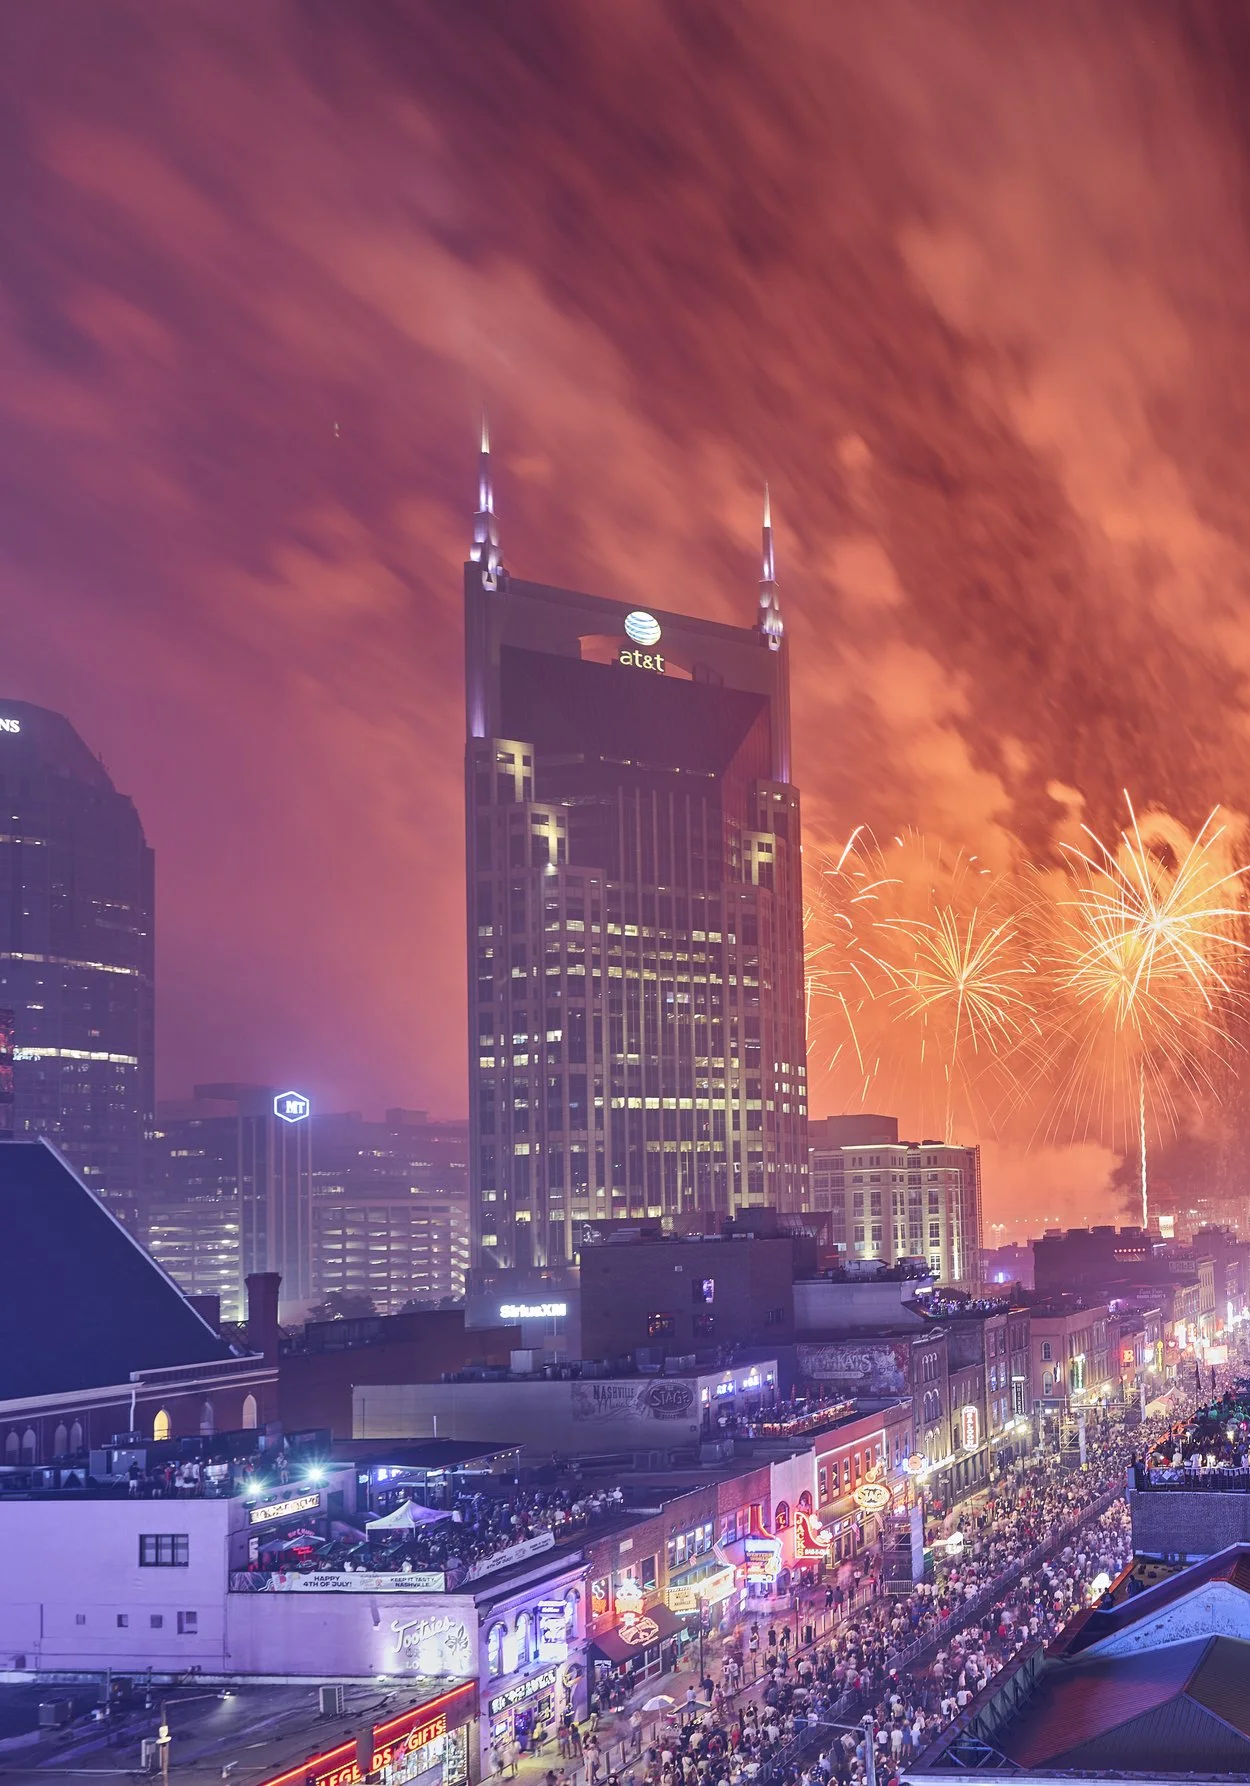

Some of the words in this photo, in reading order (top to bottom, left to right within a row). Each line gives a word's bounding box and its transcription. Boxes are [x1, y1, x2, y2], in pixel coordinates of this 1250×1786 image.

[619, 649, 665, 672] at&t
[499, 1303, 567, 1318] SiriusXM
[593, 1385, 635, 1400] NASHVILLE
[649, 1387, 691, 1407] STAGE
[796, 1516, 806, 1557] JACKS
[320, 1748, 392, 1786] EGEDS
[408, 1720, 444, 1750] GIFTS
